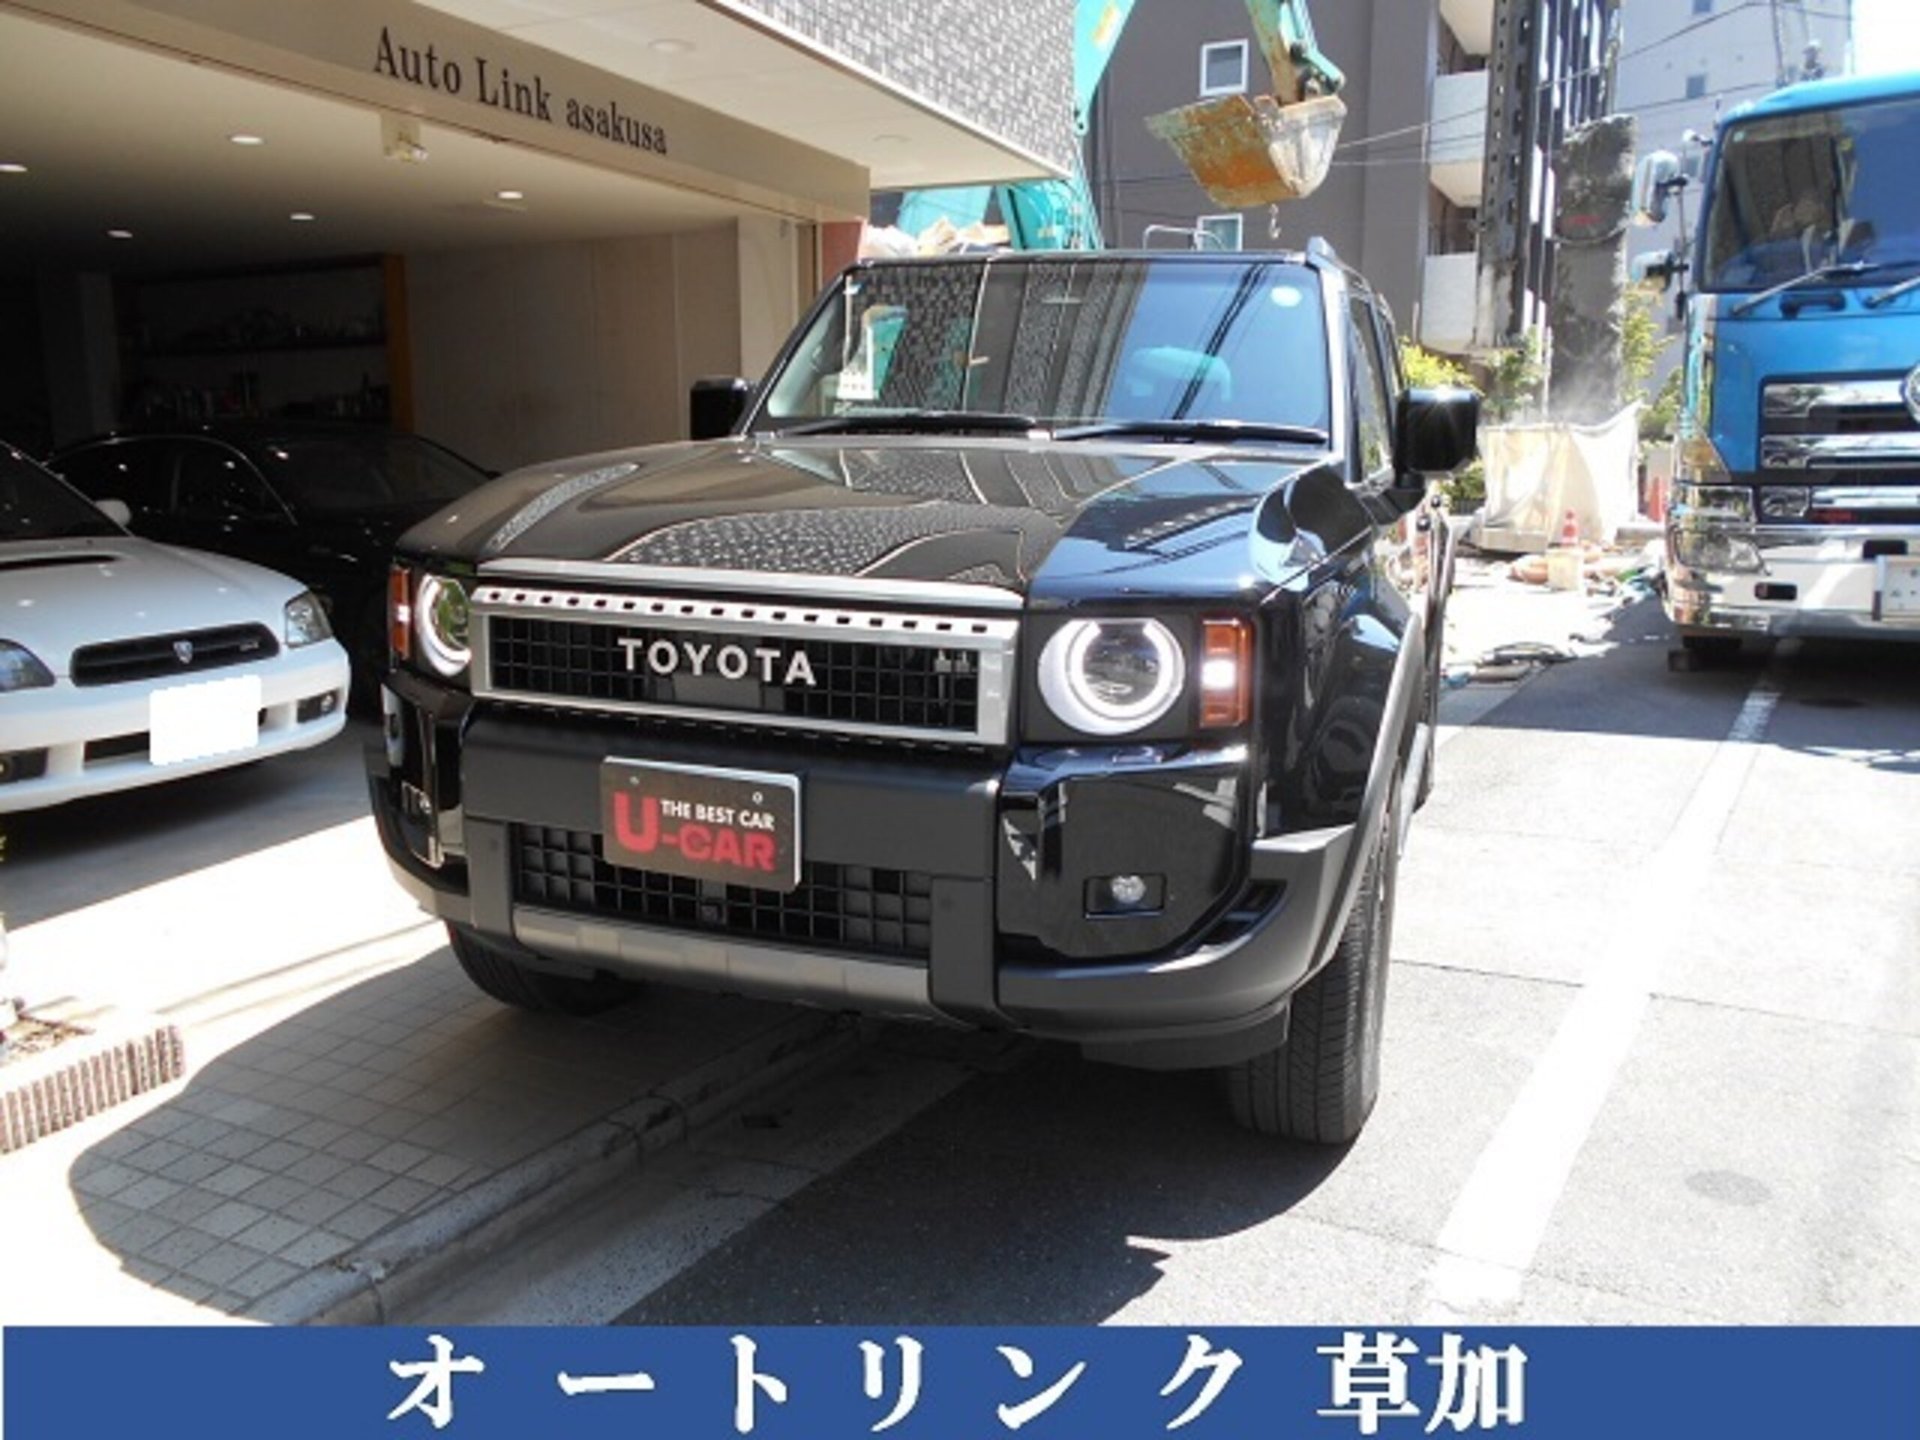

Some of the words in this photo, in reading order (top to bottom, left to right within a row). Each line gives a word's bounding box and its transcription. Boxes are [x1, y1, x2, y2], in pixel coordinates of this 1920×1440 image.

[374, 26, 462, 94] Auto
[475, 56, 552, 123] Link
[566, 98, 668, 155] asakusa
[617, 638, 817, 686] TOYOTA
[613, 791, 778, 872] U-CAR
[660, 799, 693, 820] THE
[696, 803, 736, 827] BEST
[739, 809, 776, 832] CAR
